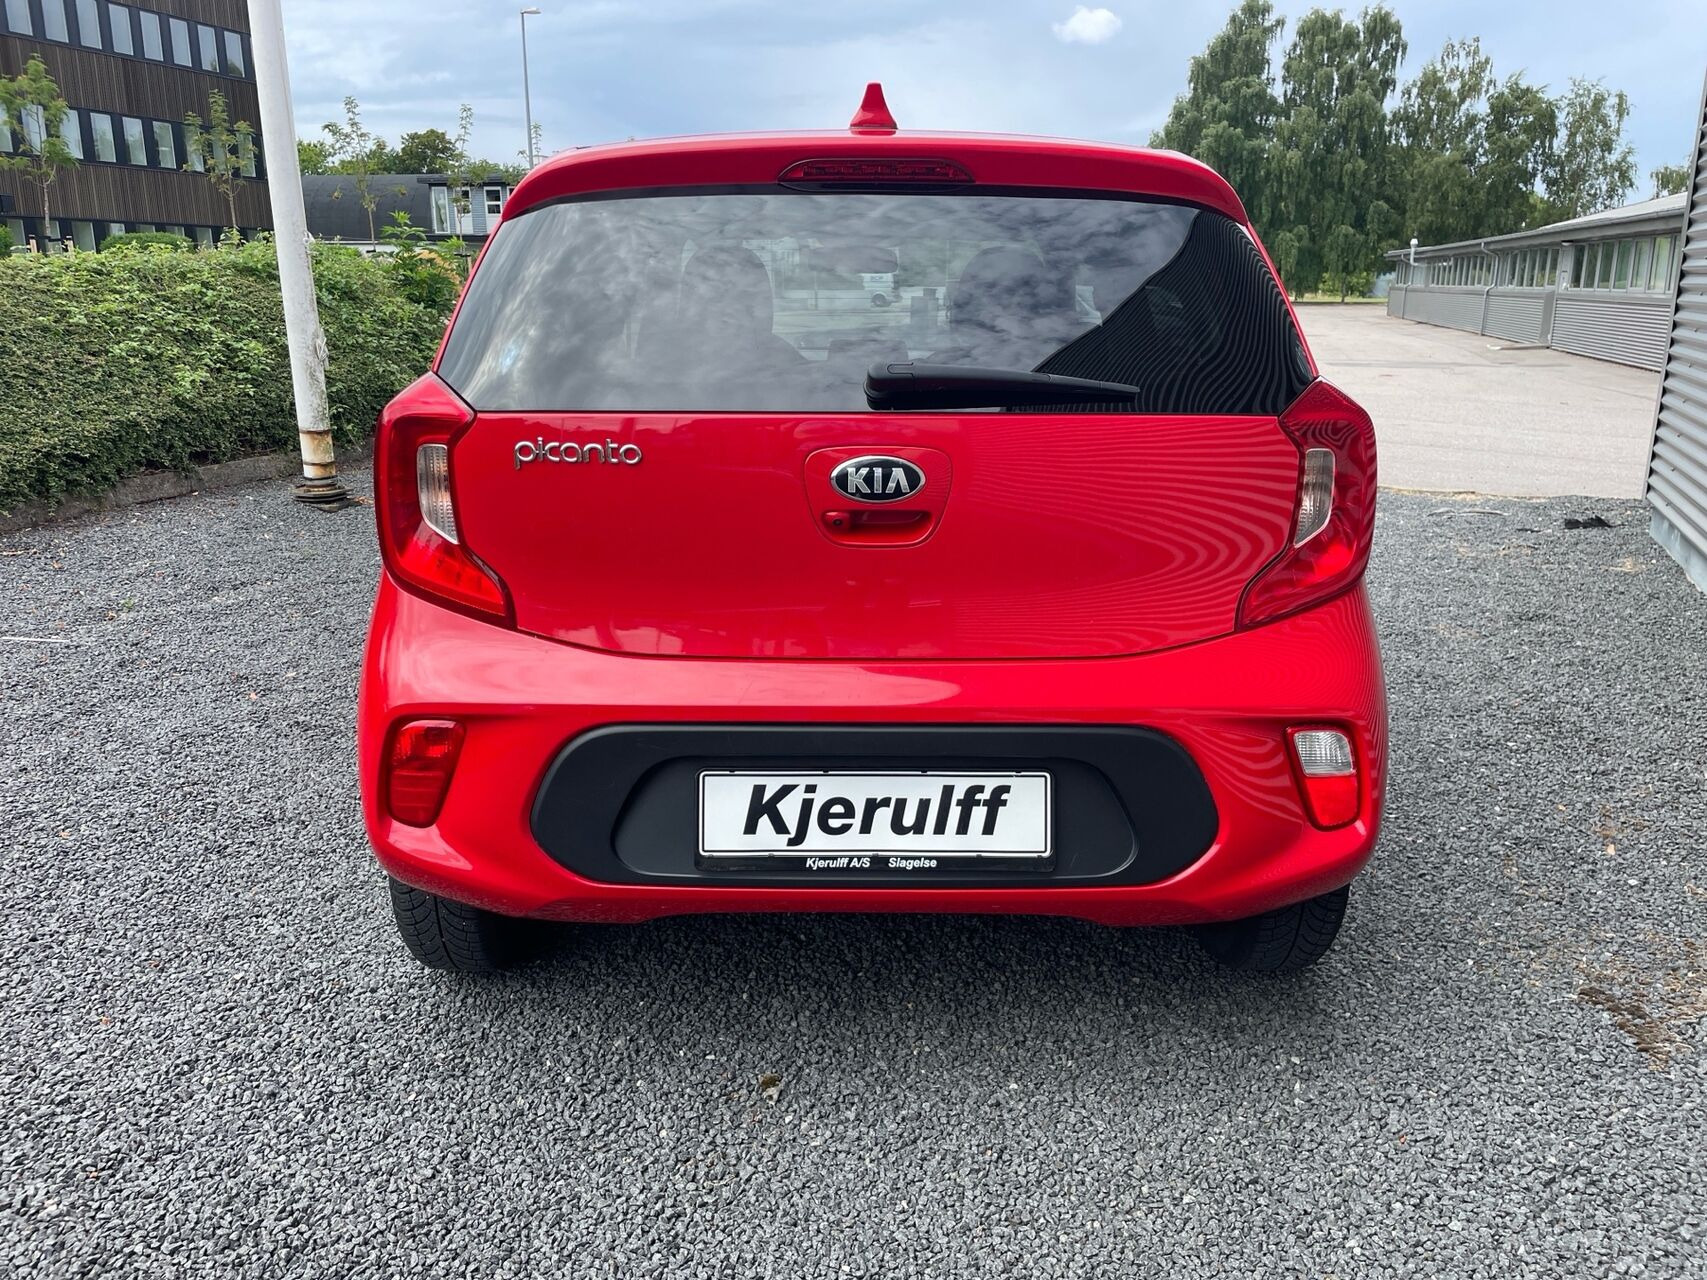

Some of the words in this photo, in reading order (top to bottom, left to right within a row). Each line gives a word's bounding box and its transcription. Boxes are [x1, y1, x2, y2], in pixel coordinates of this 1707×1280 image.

[514, 436, 642, 470] picanto
[846, 467, 911, 494] KIA
[742, 783, 1011, 847] Kjerulff
[805, 857, 849, 870] Kjerulff
[849, 857, 871, 868] A/S
[888, 857, 937, 870] Slagelse
